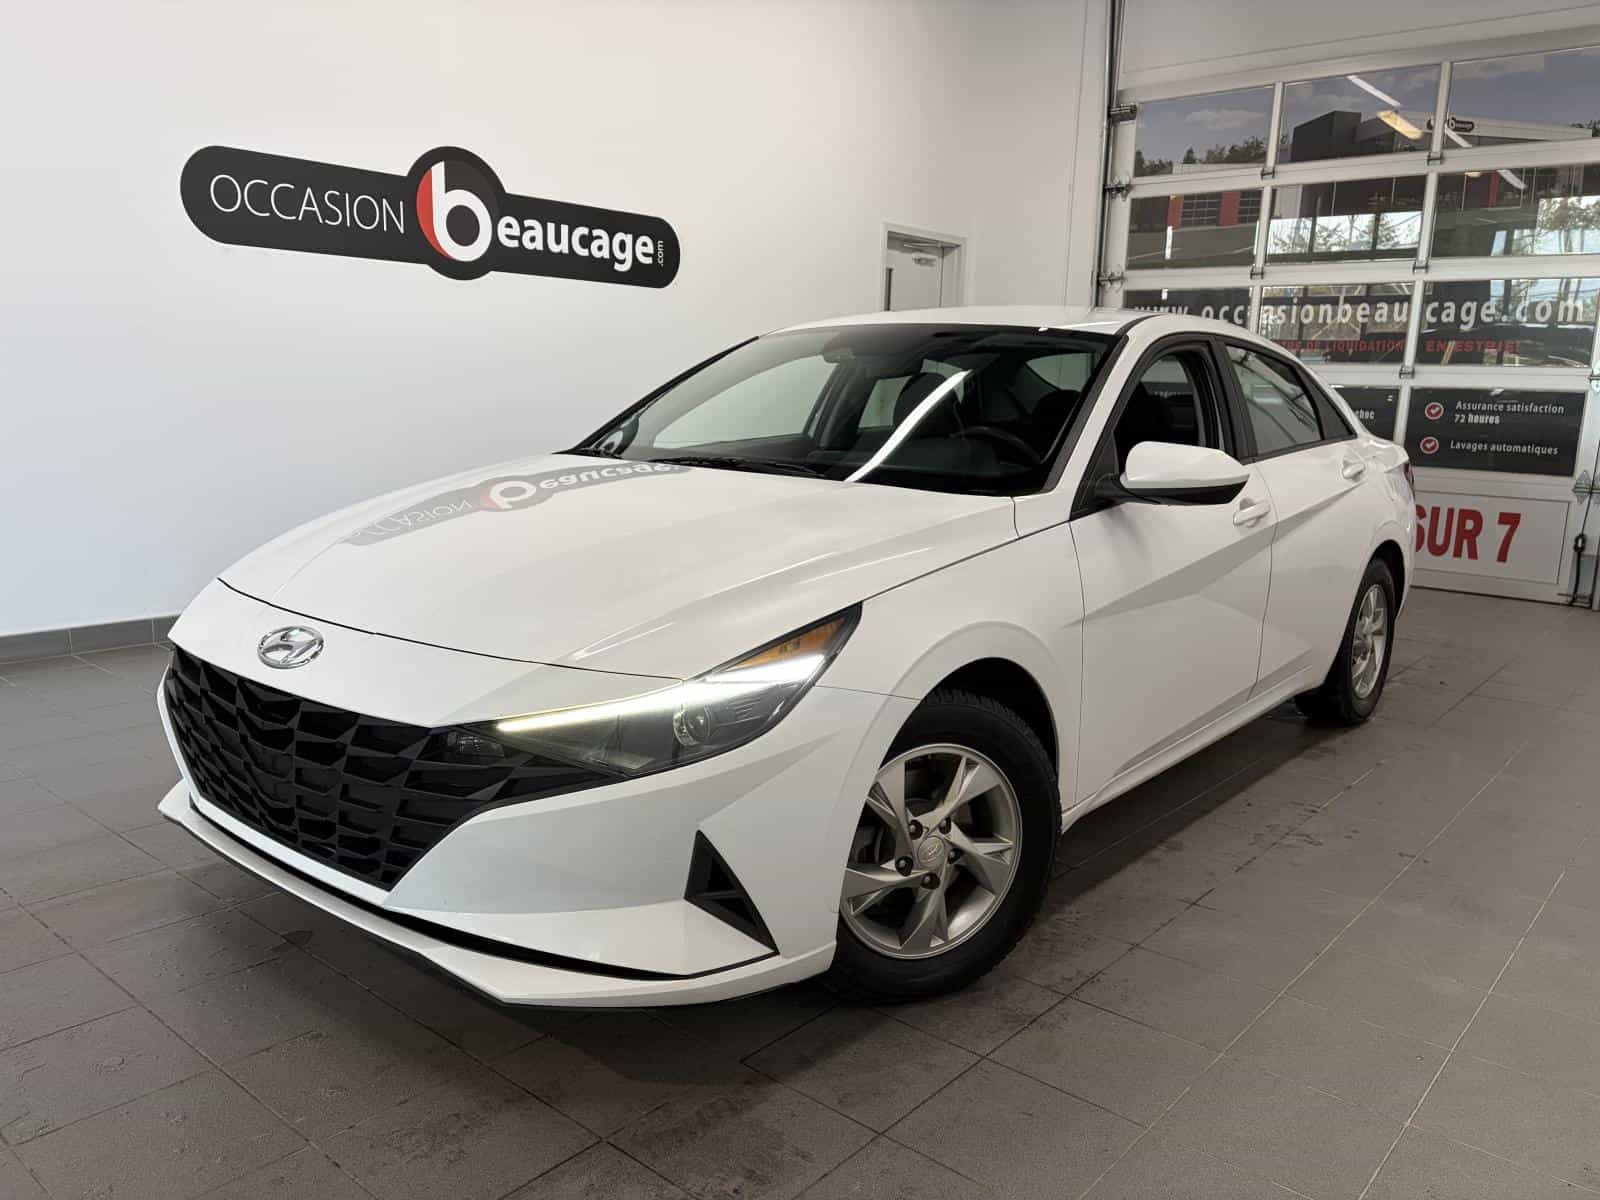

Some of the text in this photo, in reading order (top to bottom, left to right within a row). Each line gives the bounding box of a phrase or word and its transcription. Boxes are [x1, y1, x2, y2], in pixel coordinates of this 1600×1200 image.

[209, 173, 405, 235] OCCASION
[1455, 400, 1565, 414] Assurance satisfaction
[1454, 413, 1500, 425] 72 heures
[1450, 440, 1559, 456] Lavages automatiques
[1496, 511, 1522, 563] 7
